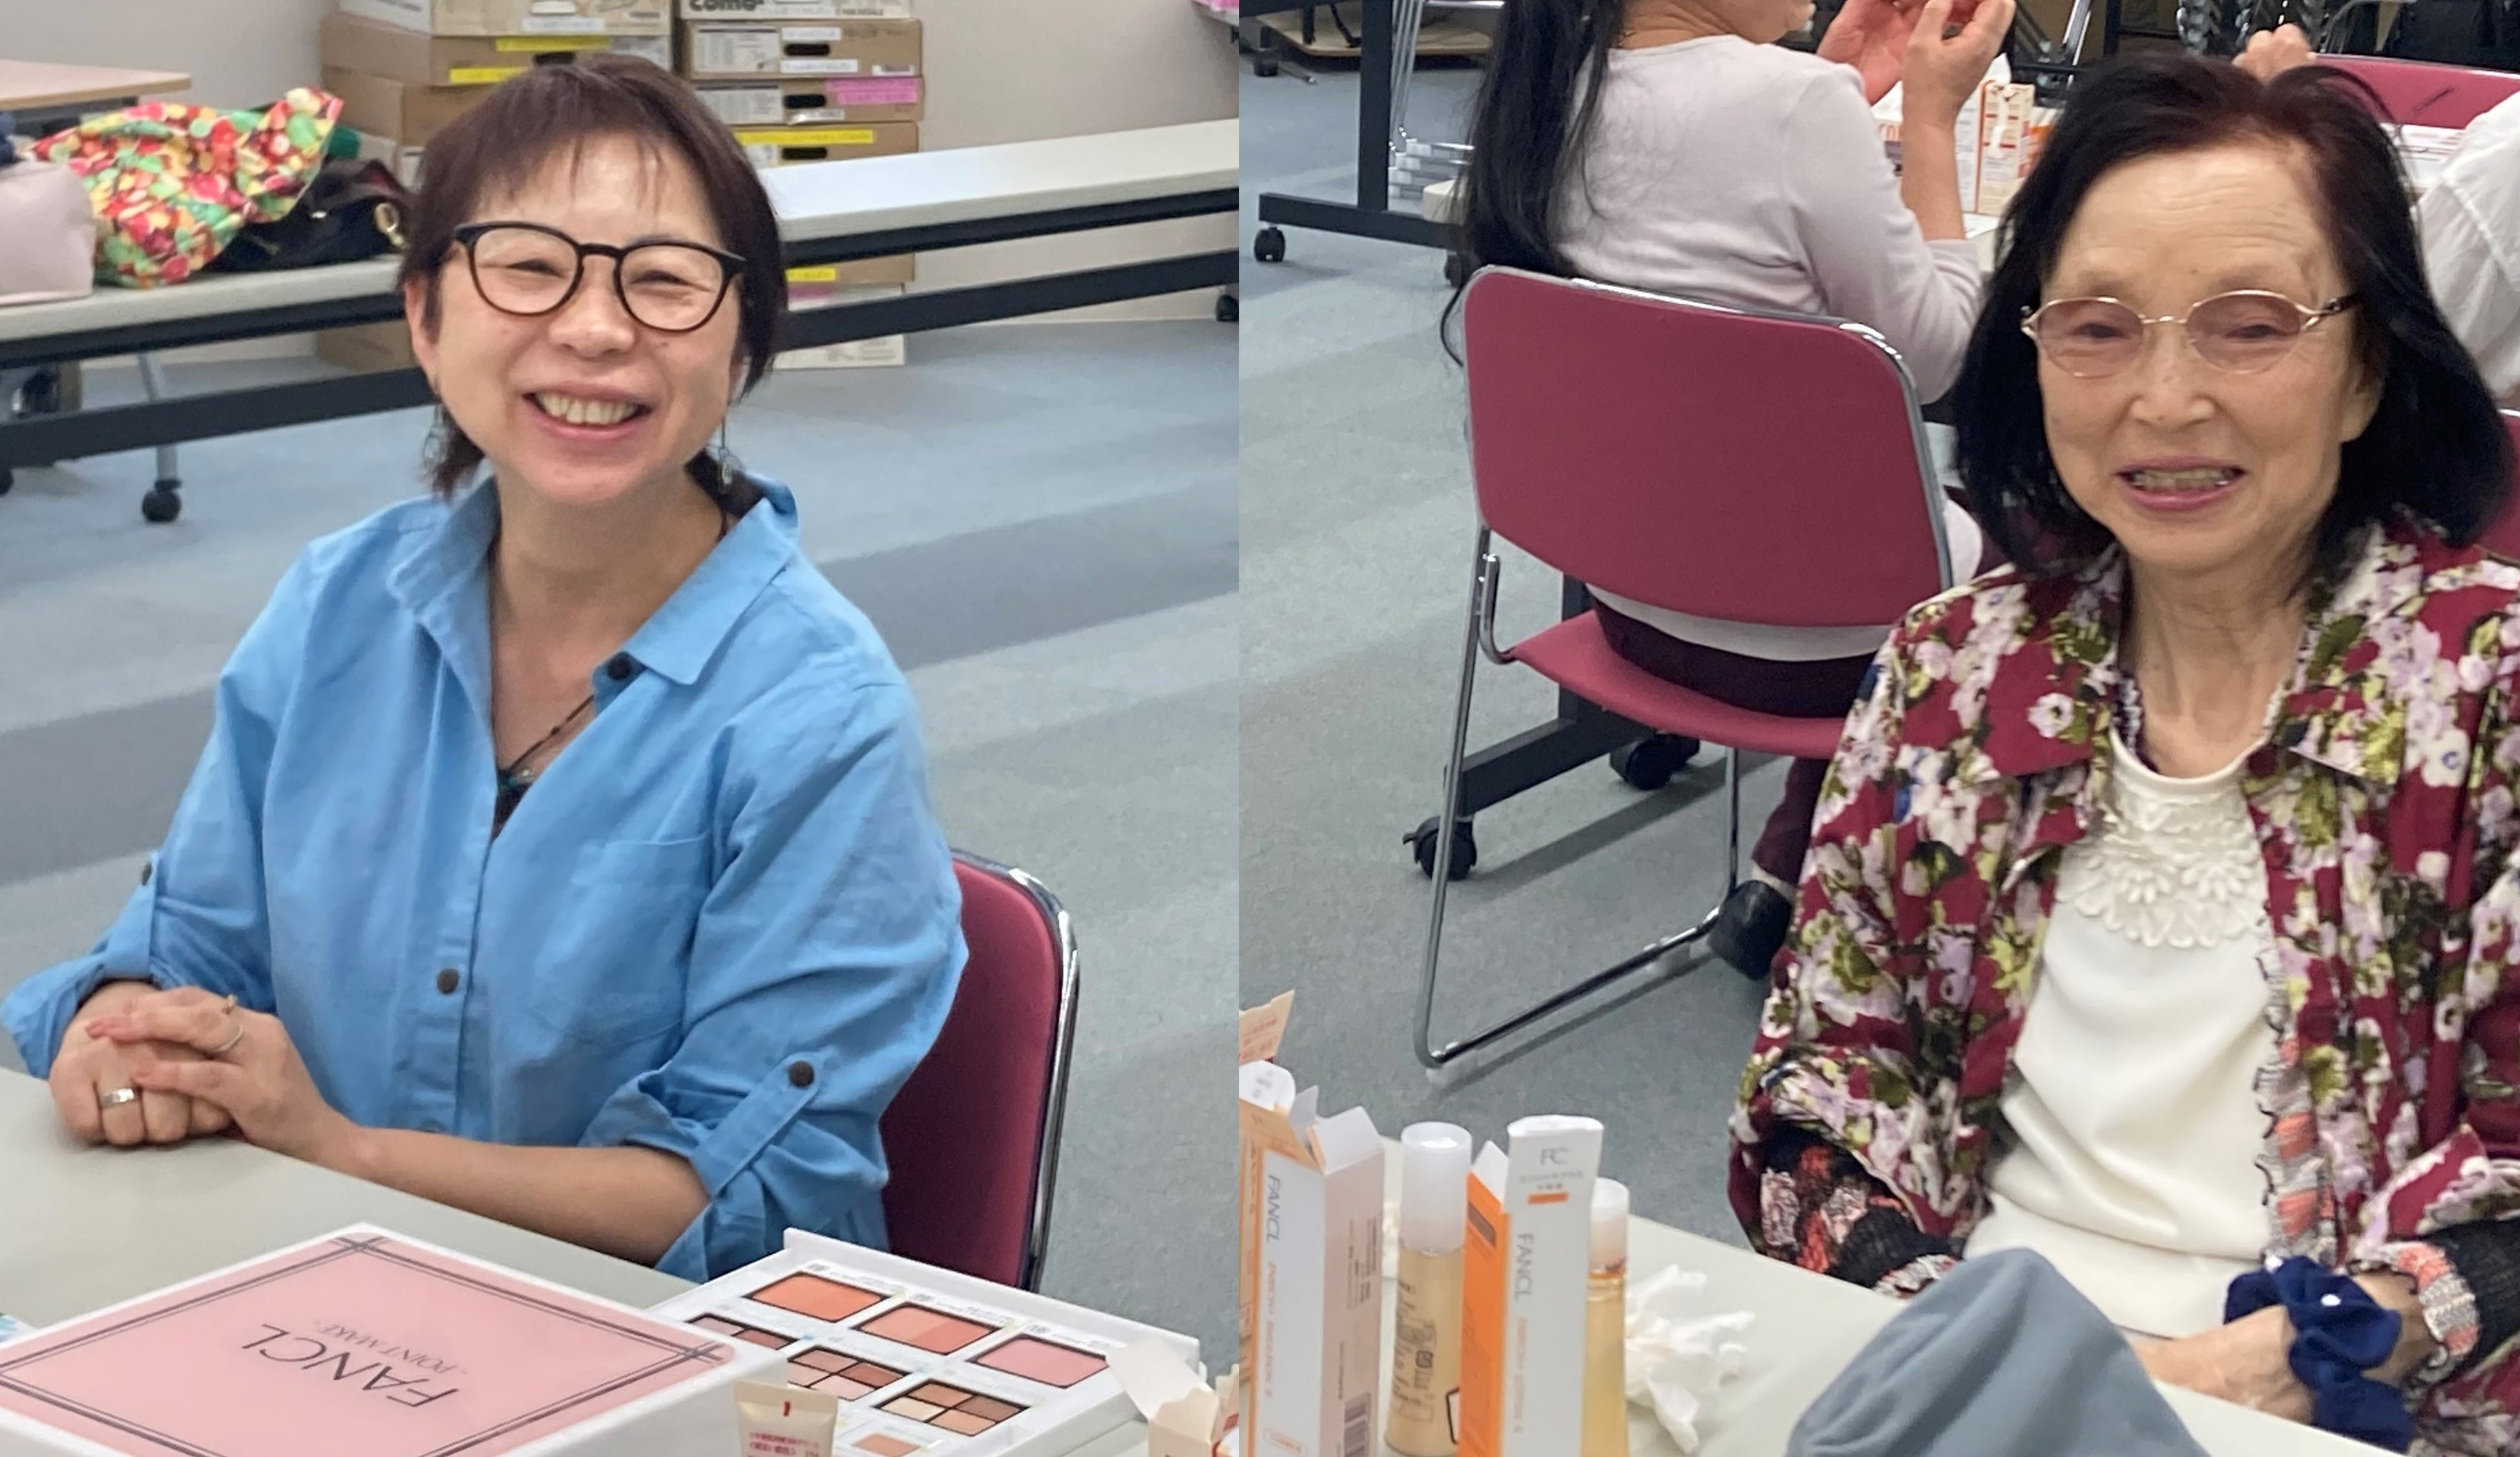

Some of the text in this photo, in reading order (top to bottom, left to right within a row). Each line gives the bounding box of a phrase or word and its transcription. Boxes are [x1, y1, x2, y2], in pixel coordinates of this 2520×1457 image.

[1266, 1174, 1281, 1242] FANCL
[1515, 1233, 1534, 1303] FANCL
[241, 1323, 459, 1407] FANCL
[381, 1346, 458, 1374] POINT
